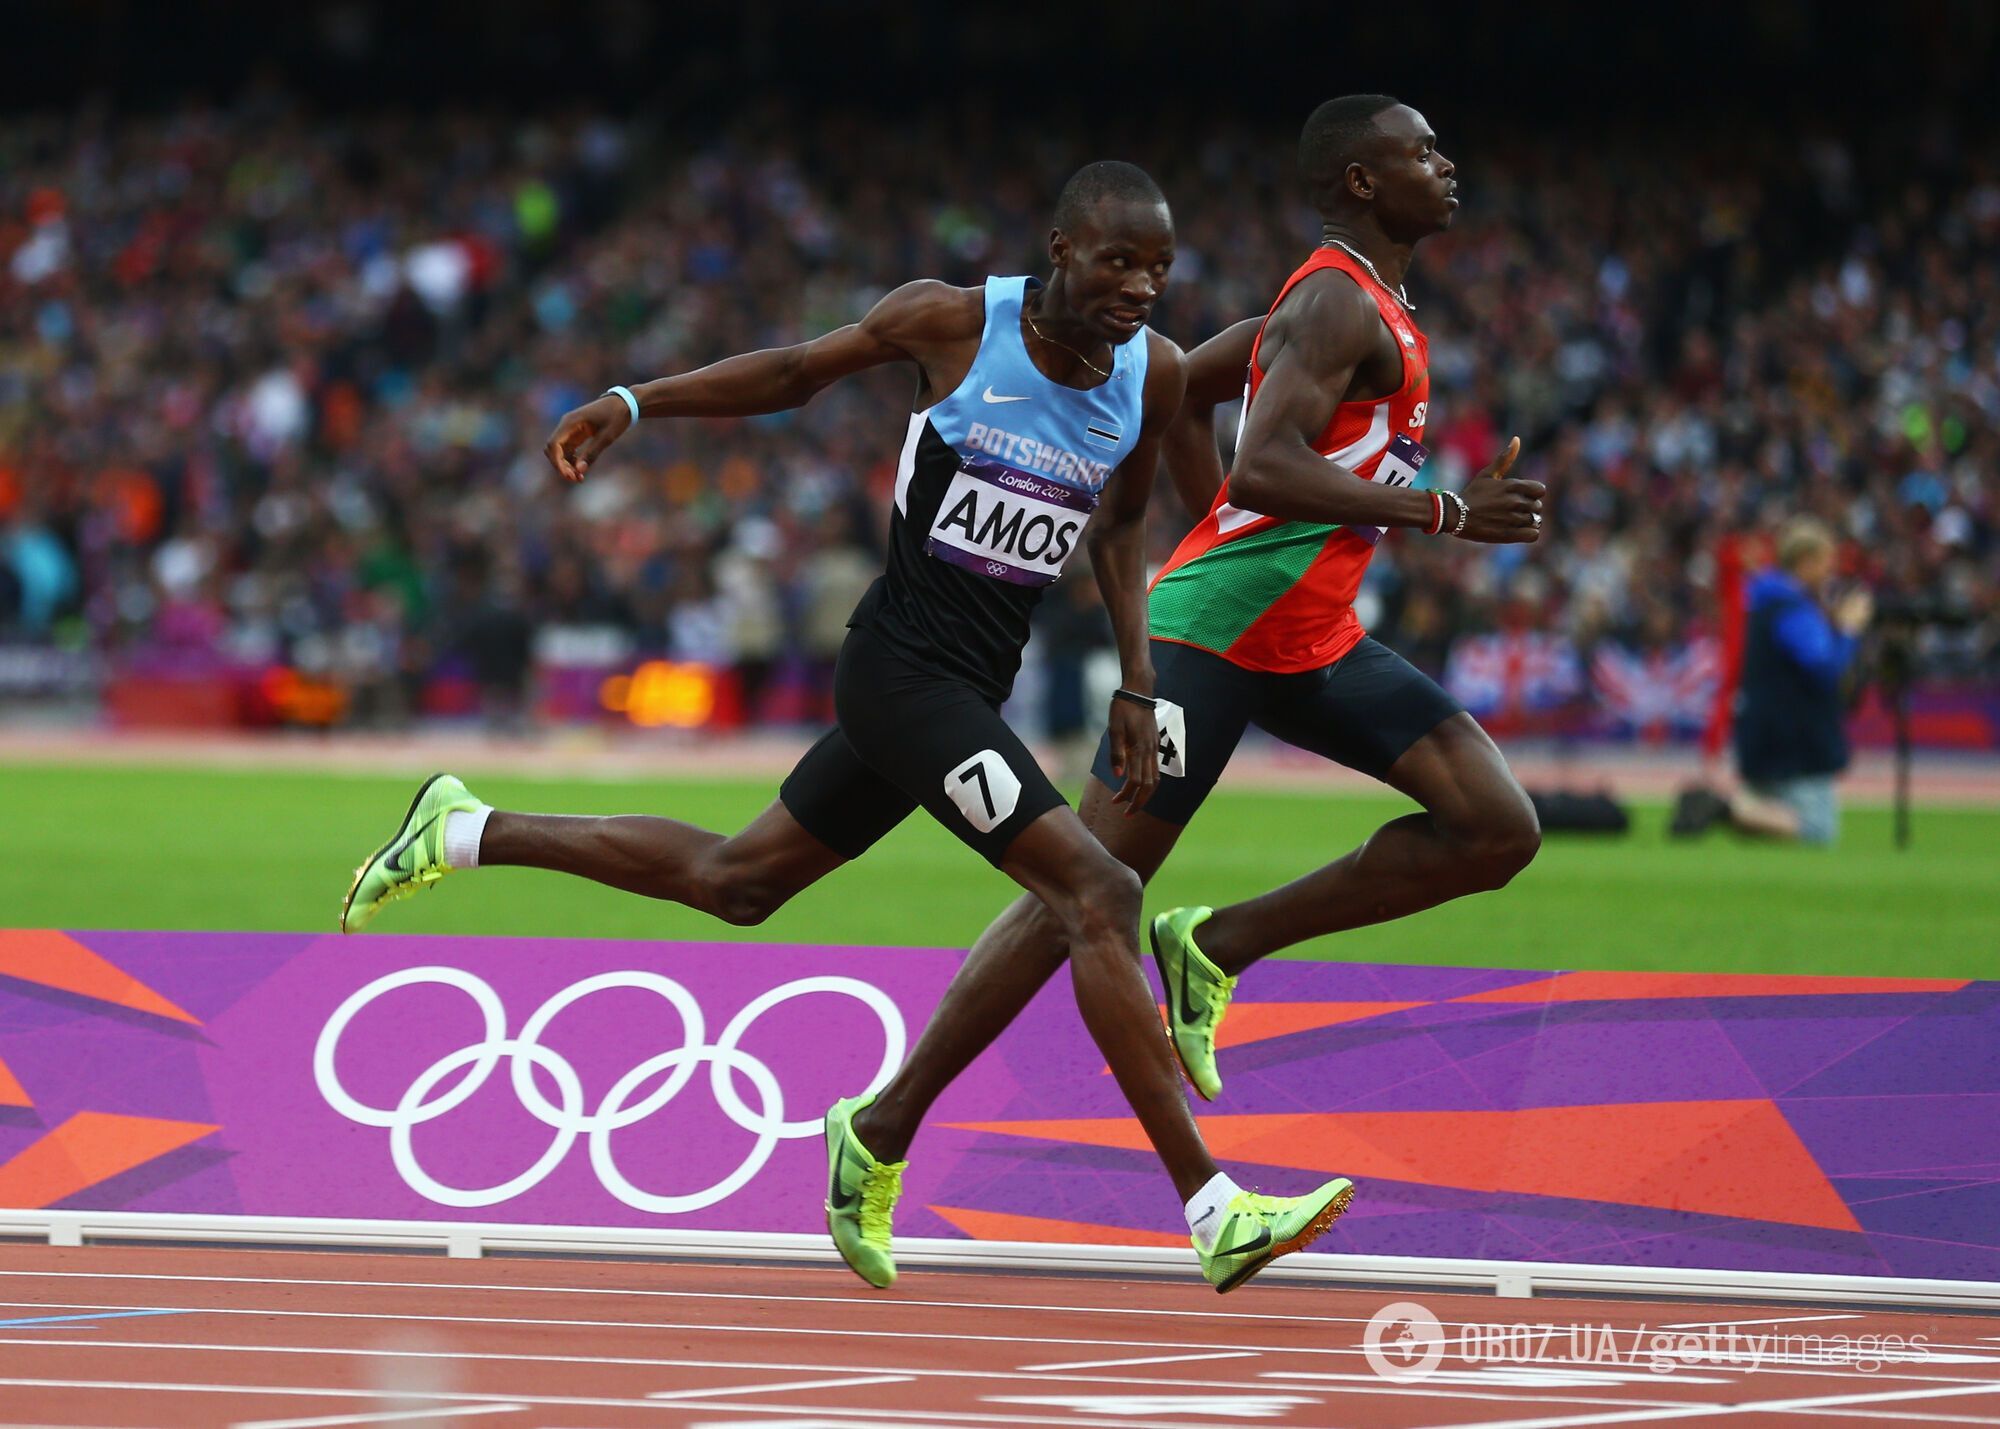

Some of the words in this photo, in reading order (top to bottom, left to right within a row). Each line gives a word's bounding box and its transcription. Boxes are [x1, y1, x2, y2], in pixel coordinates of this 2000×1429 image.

[998, 470, 1041, 494] London
[1043, 484, 1071, 501] 2012
[937, 489, 1078, 566] AMOS
[1159, 726, 1177, 766] 4
[958, 761, 997, 821] 7
